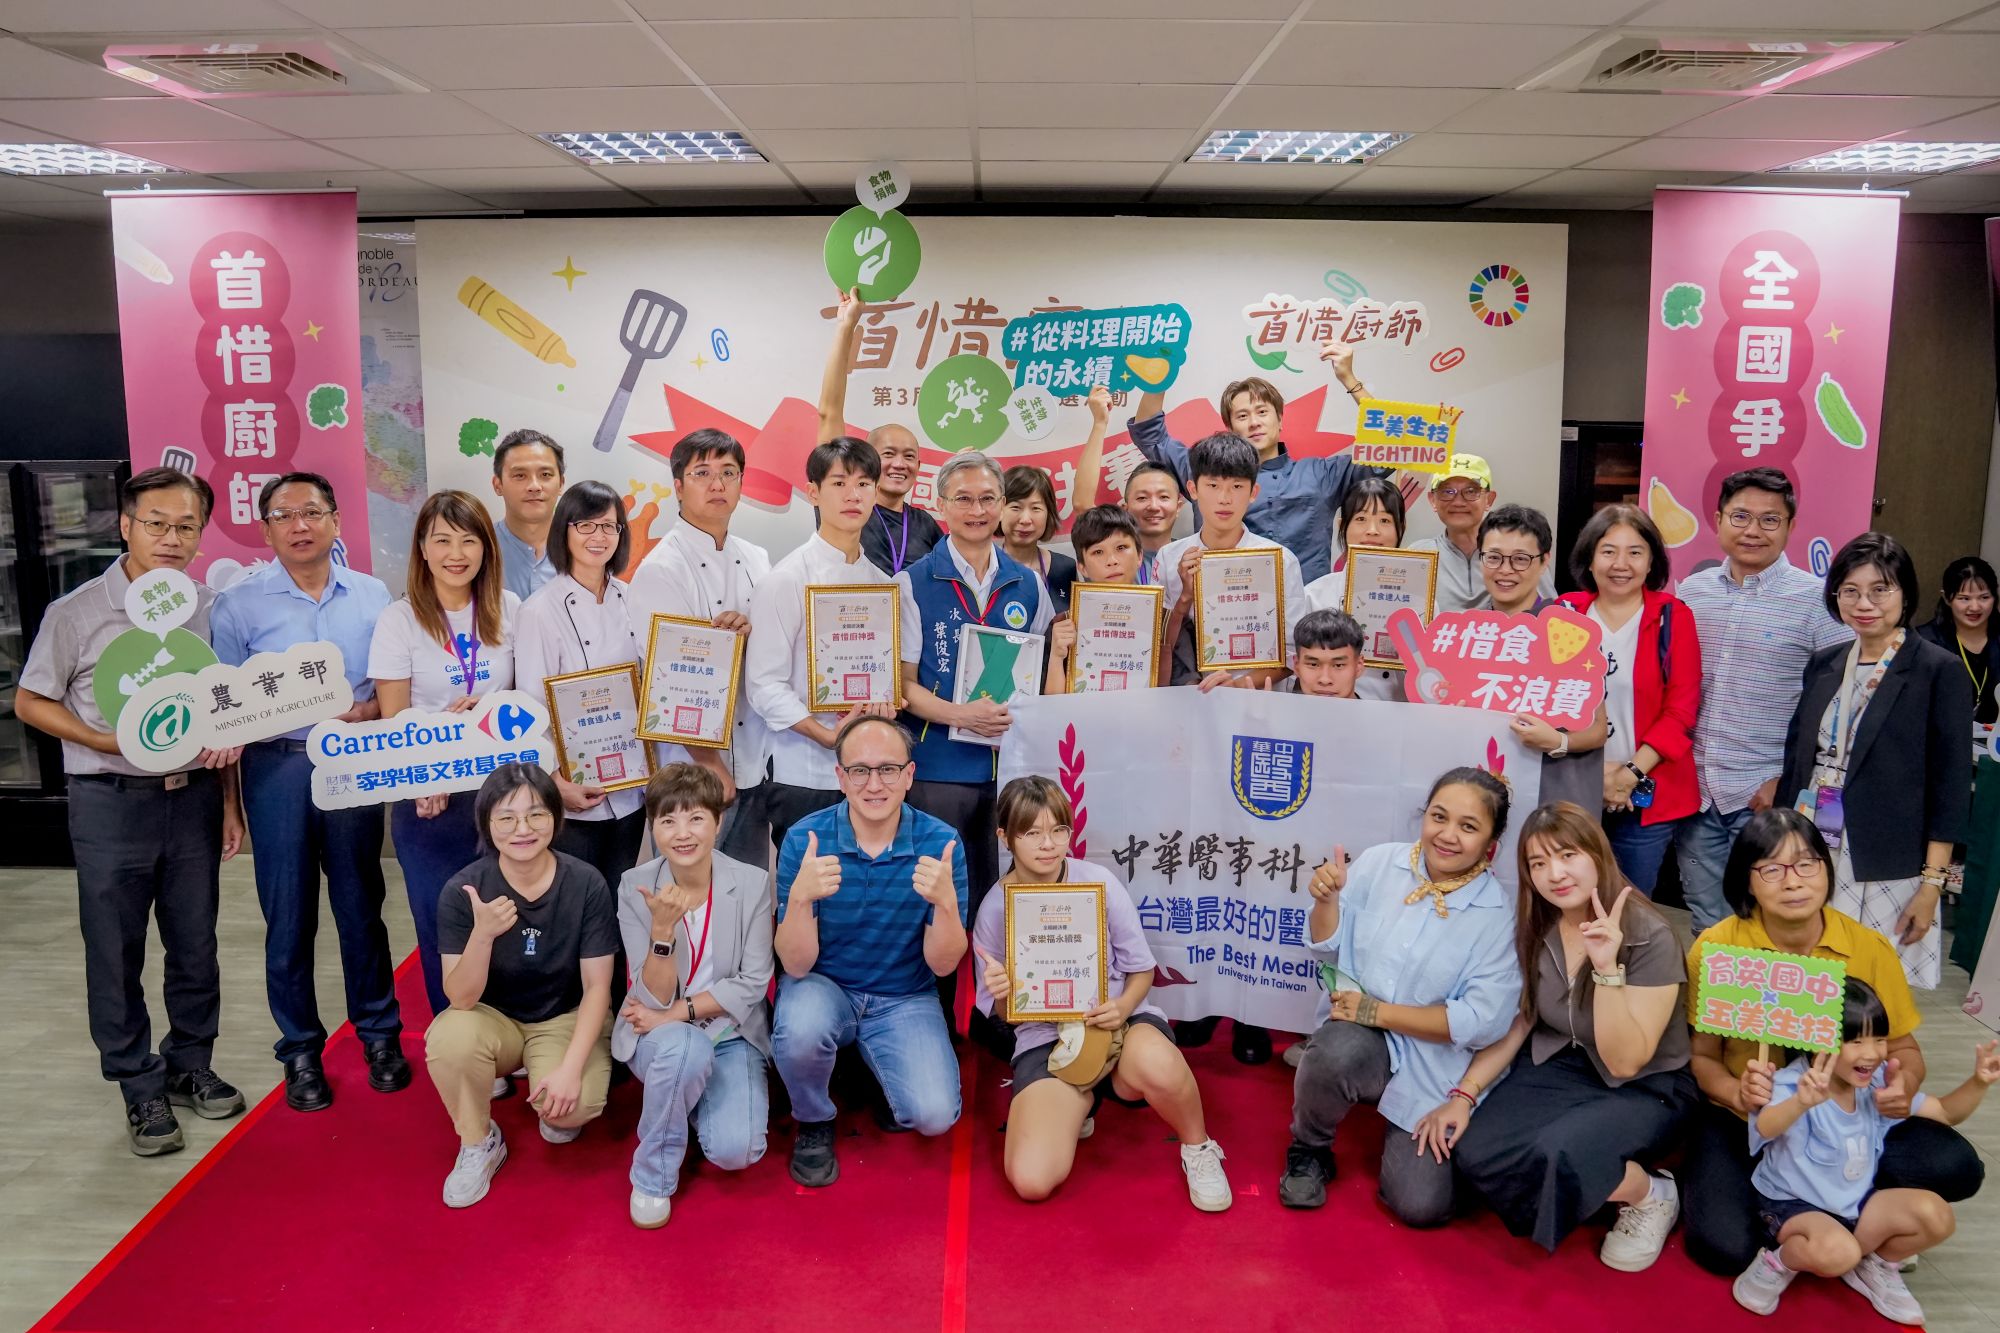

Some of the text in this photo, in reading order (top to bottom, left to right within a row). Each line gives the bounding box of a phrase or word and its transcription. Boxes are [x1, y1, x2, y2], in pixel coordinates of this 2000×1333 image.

[358, 264, 373, 274] de
[1011, 313, 1183, 354] #從料理開始
[1249, 301, 1422, 346] 首惜廚師
[1023, 355, 1115, 389] 的永續
[1730, 251, 1799, 457] 全國爭
[1364, 409, 1450, 444] 玉美生技
[1353, 445, 1446, 464] FIGHTING
[140, 581, 171, 604] 食物
[142, 591, 188, 621] 不浪費
[933, 621, 951, 673] 葉俊宏
[1432, 620, 1538, 664] #惜食
[209, 658, 328, 715] 農業部
[445, 660, 490, 673] Careour
[450, 670, 490, 686] 家福
[215, 691, 337, 732] MINISTRY OF AGRICULTURE
[1471, 672, 1592, 720] 不浪費
[321, 722, 465, 757] Carrefour
[1111, 830, 1352, 894] 中華醫事科
[1137, 895, 1306, 947] 台灣最好的醫
[1187, 945, 1216, 965] The
[1223, 943, 1257, 970] Best
[1217, 965, 1307, 993] University in Taiwan
[1706, 951, 1840, 1005] 育英國中
[1701, 998, 1838, 1048] 玉美生技
